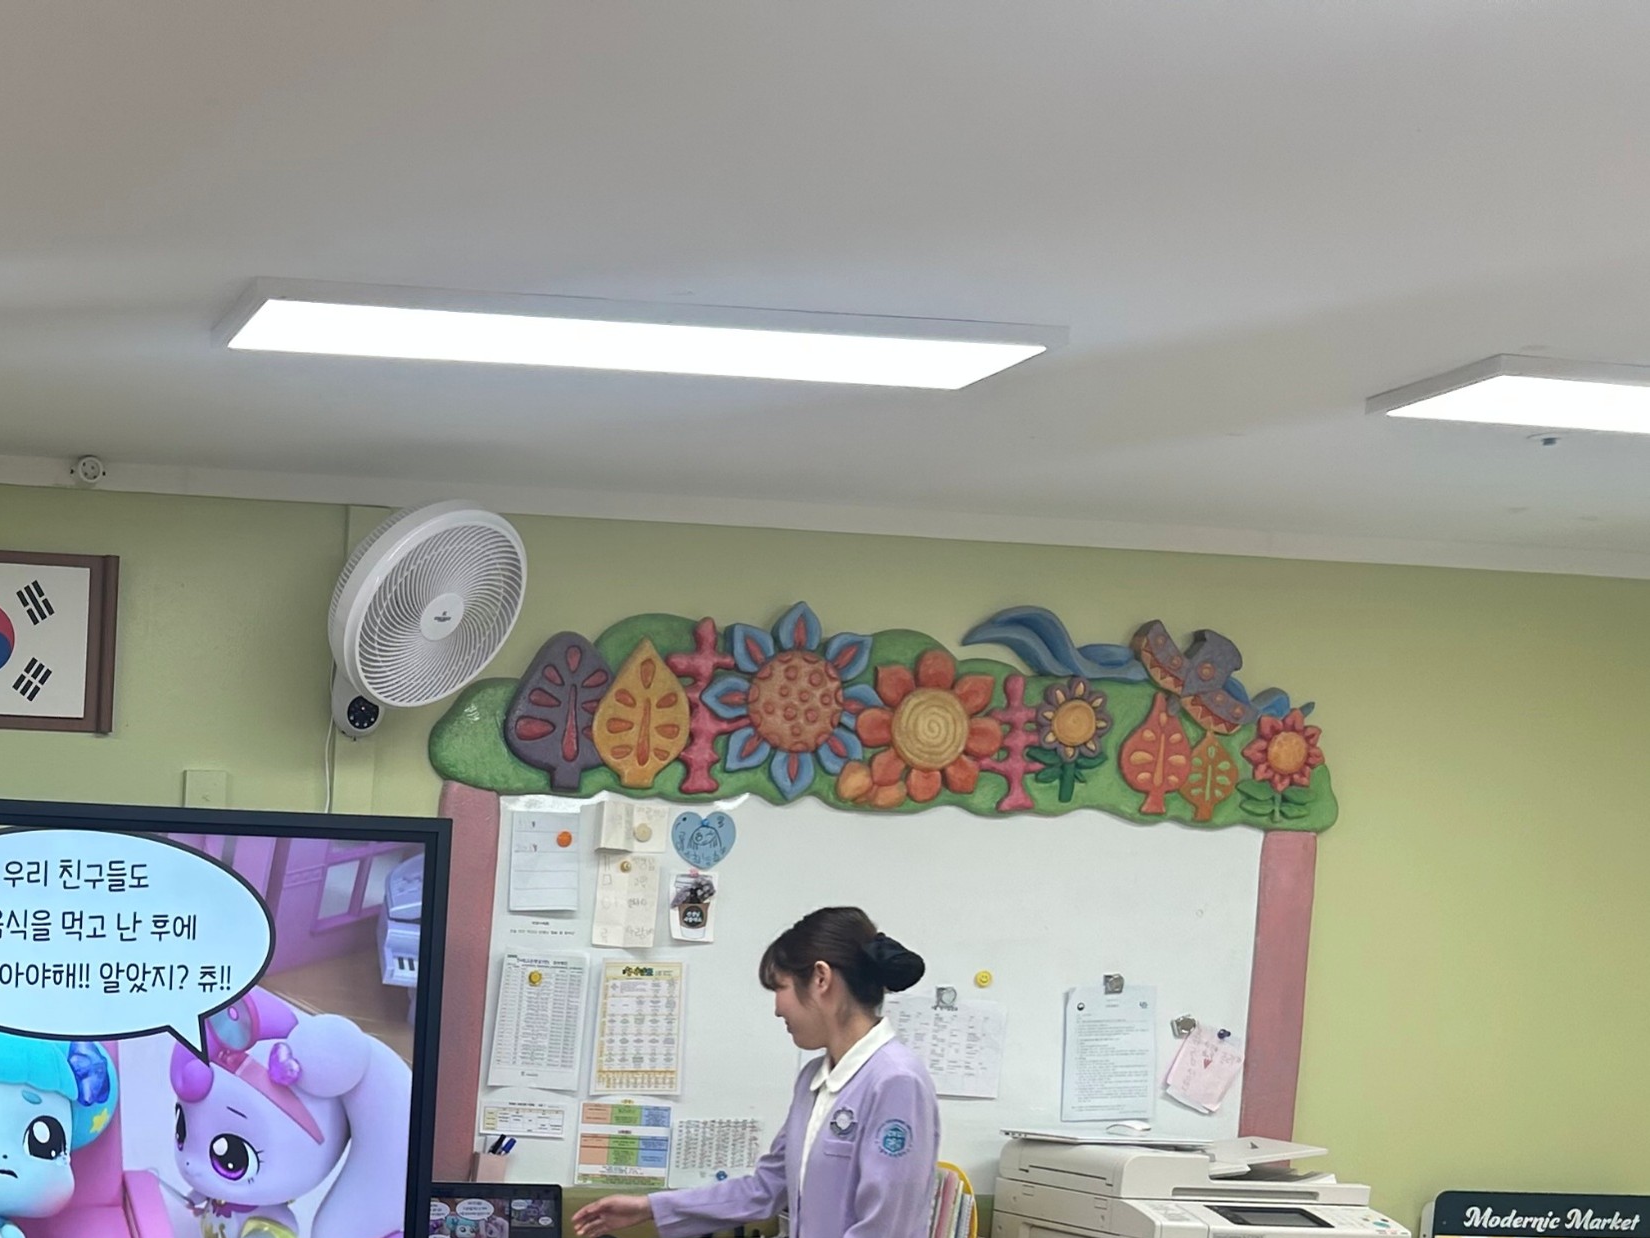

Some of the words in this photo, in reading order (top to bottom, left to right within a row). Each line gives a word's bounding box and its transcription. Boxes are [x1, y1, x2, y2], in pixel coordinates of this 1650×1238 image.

[3, 860, 48, 888] 우리
[59, 859, 150, 892] 친구들도
[61, 912, 107, 941] 먹고
[116, 912, 143, 941] 난
[150, 914, 197, 941] 후에
[99, 961, 189, 993] 알았지?
[198, 964, 232, 993] 츄!!
[1463, 1206, 1561, 1233] Modernic
[1564, 1208, 1641, 1231] Market
